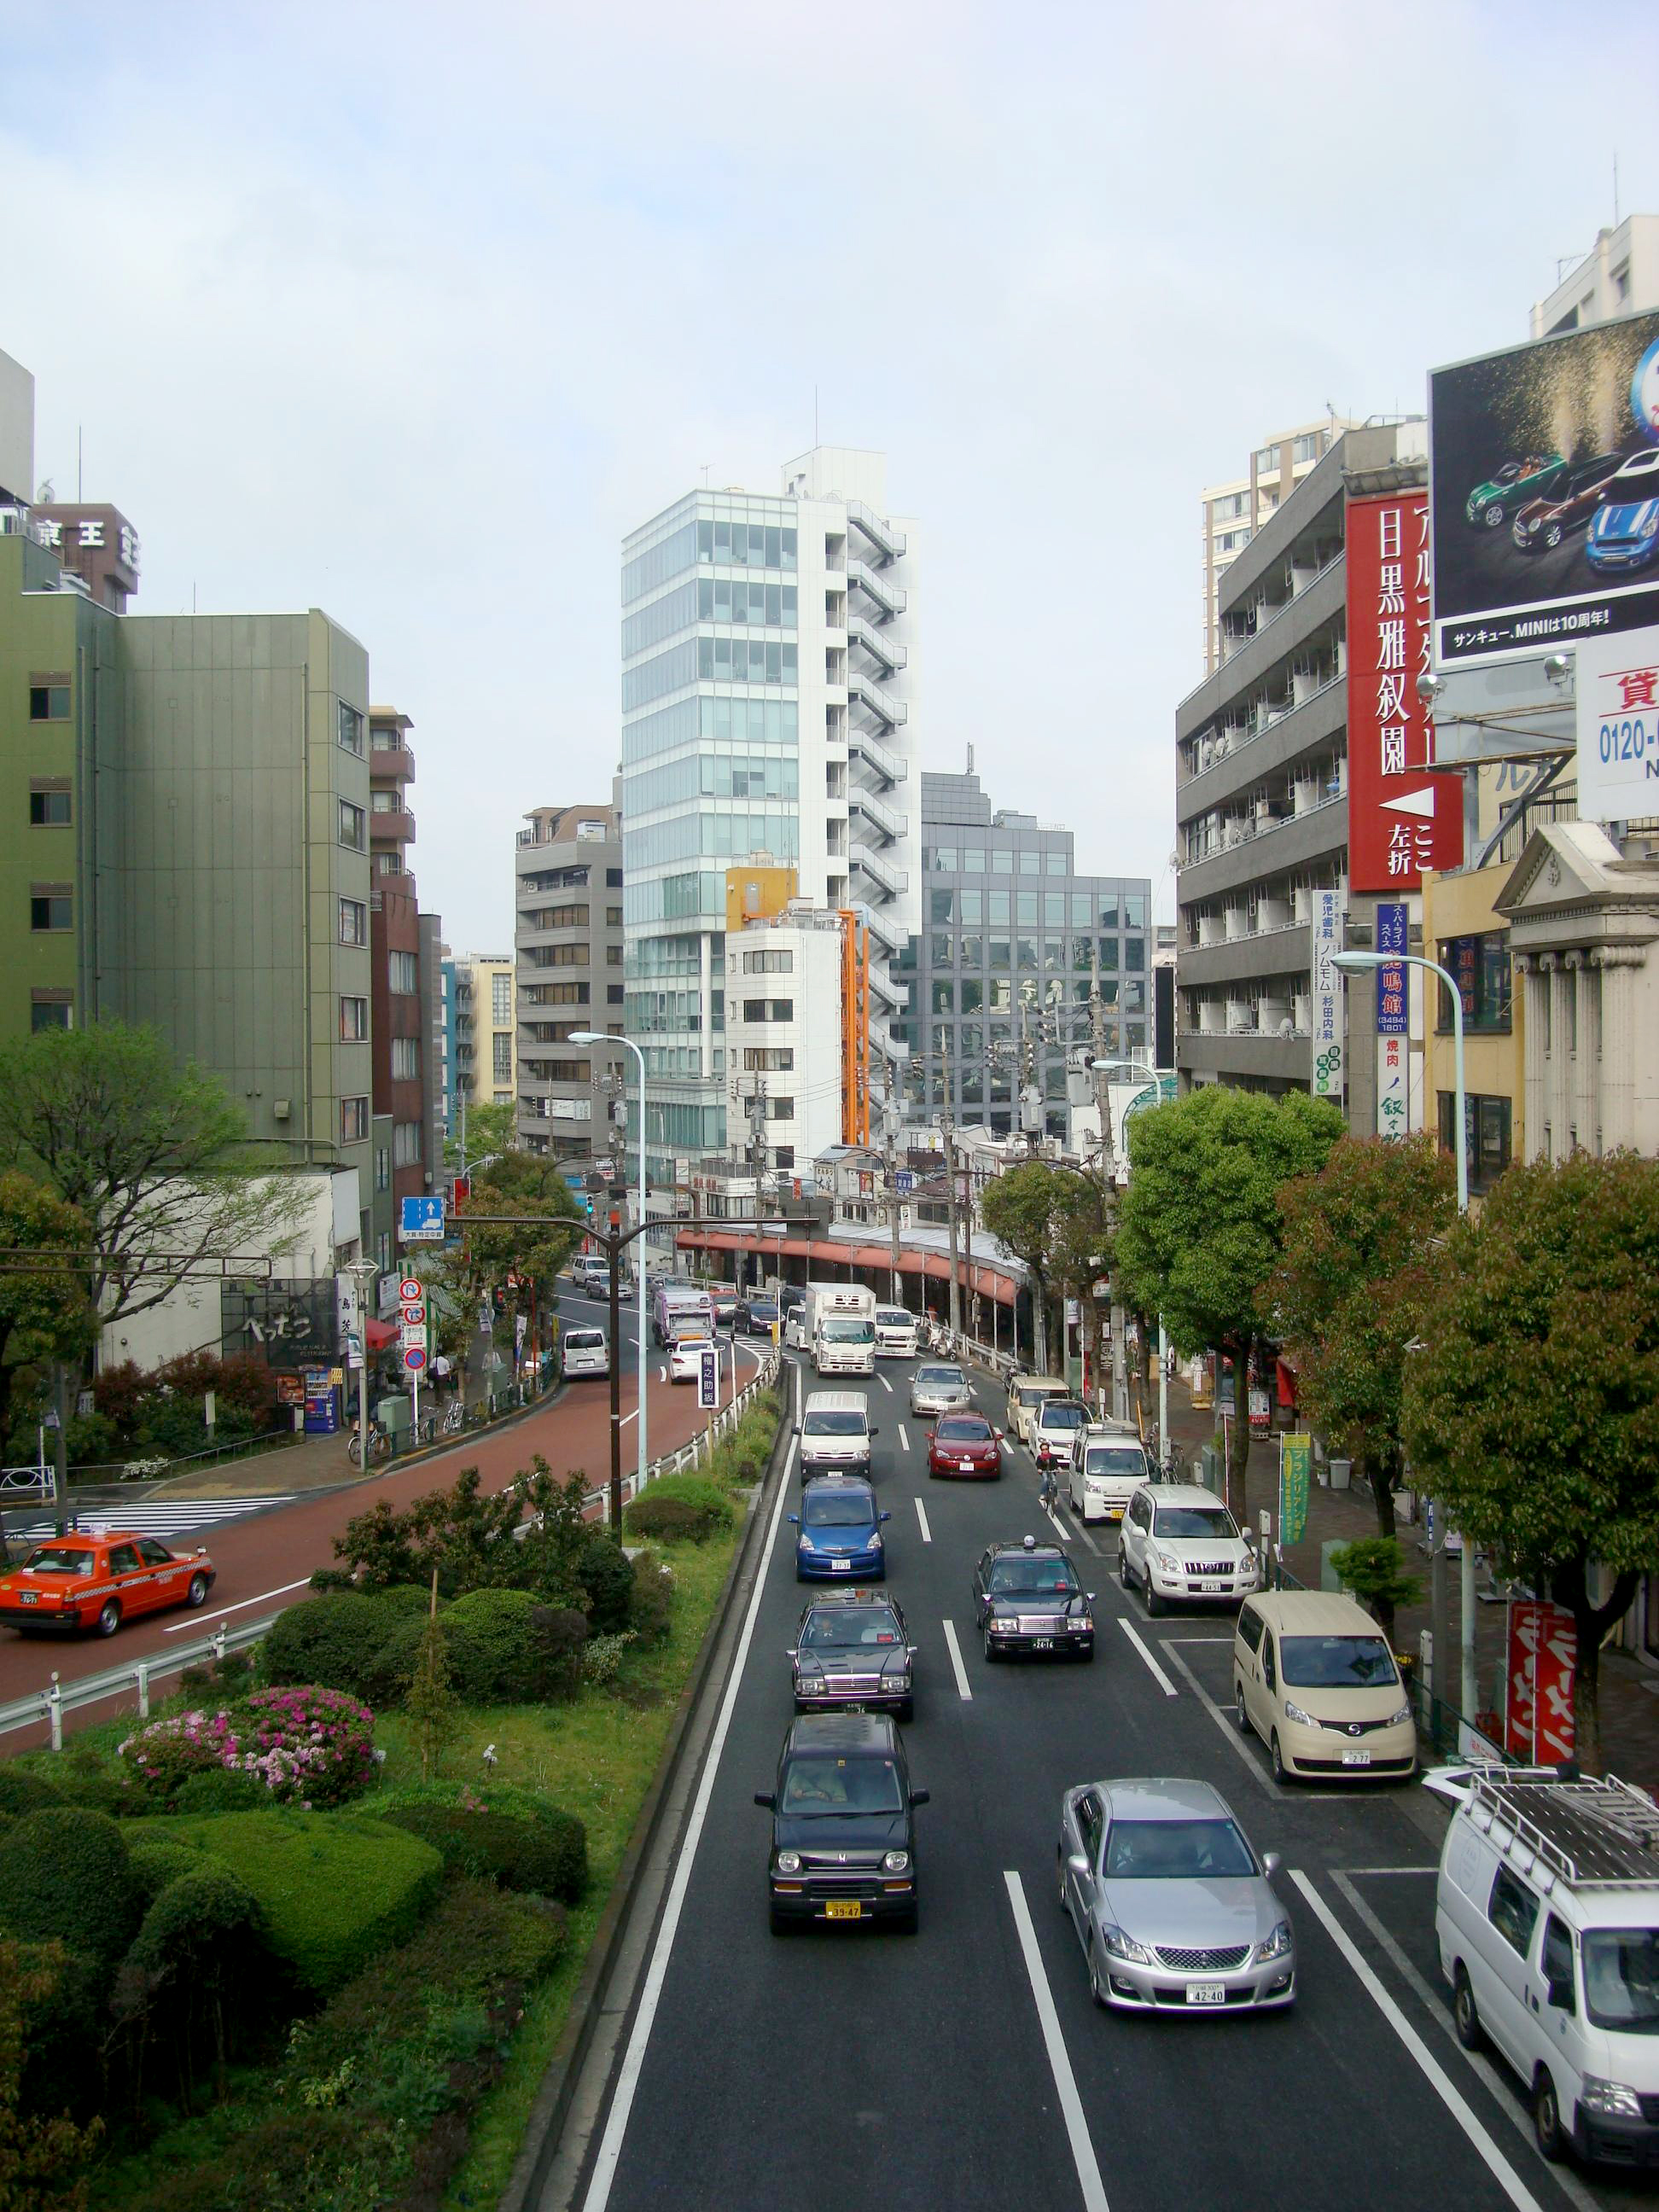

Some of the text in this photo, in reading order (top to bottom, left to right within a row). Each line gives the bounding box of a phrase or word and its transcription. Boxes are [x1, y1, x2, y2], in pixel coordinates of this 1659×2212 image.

[1376, 508, 1411, 776] 目黒雅叙園
[1599, 719, 1659, 764] 0120-
[1388, 824, 1412, 876] 左折
[1414, 824, 1434, 871] ここ
[1322, 894, 1334, 940] 愛児歯科
[1322, 996, 1334, 1040] 杉田内科
[1387, 1039, 1399, 1067] 焼肉
[1195, 1991, 1223, 2001] 42-40
